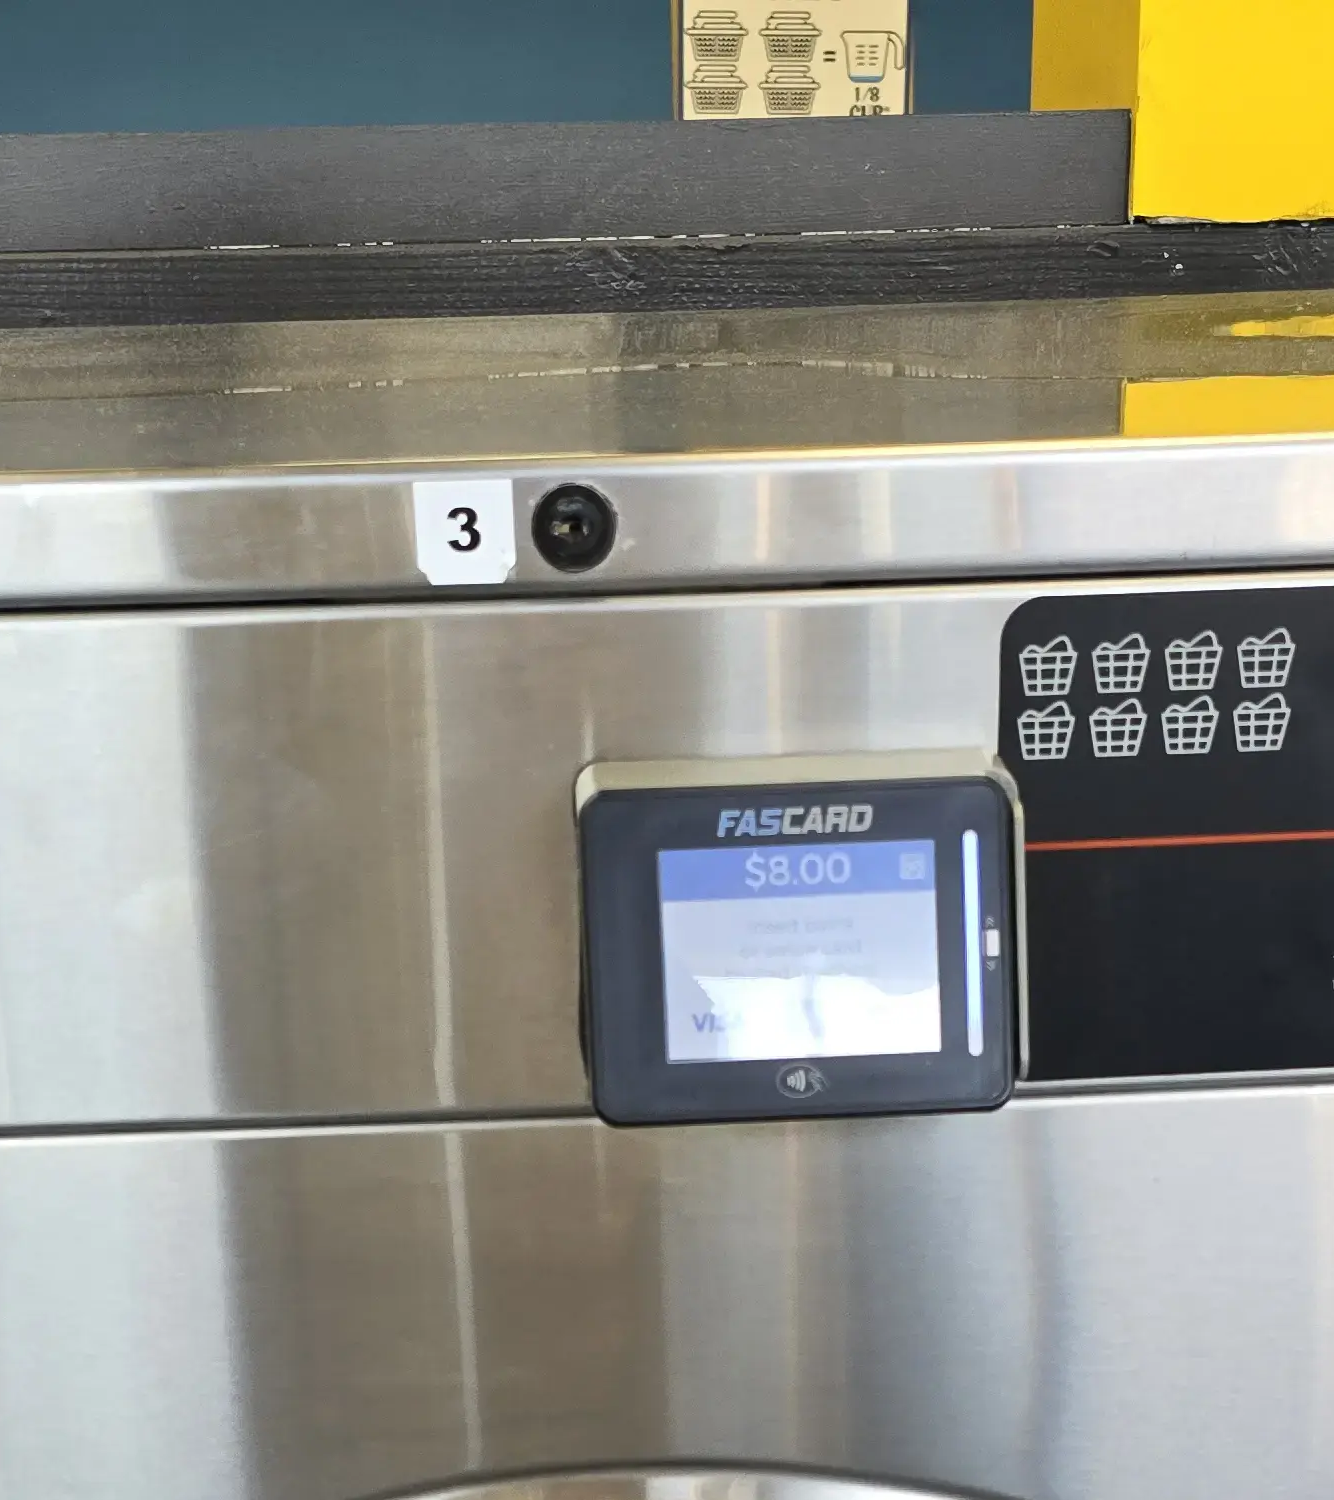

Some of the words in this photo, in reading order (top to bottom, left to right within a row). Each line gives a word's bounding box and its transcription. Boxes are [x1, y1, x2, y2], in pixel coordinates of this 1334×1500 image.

[855, 86, 880, 103] 1/8
[447, 507, 481, 551] 3
[717, 804, 873, 838] FASCARD
[744, 850, 851, 892] $8.00
